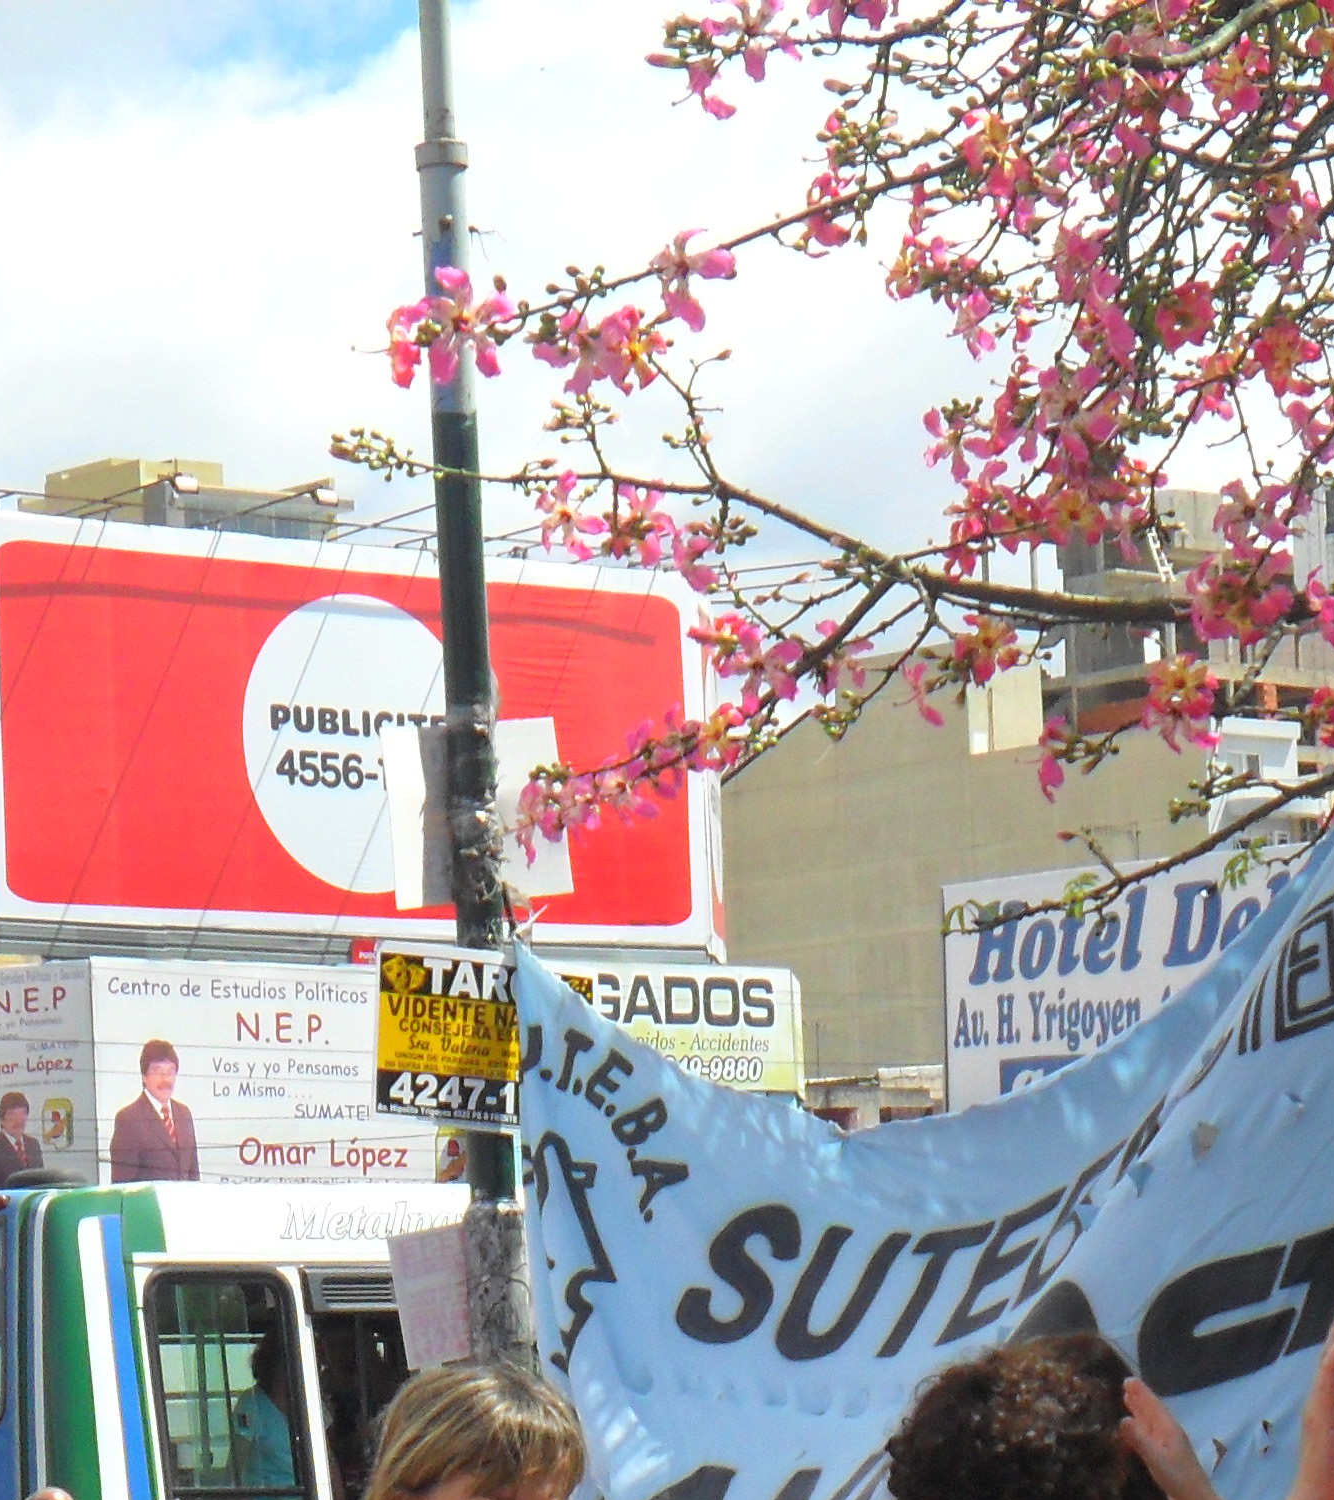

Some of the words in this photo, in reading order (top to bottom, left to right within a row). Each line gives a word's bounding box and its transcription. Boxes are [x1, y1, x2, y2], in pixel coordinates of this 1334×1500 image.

[968, 885, 1148, 986] Hotel
[107, 976, 170, 998] Centro
[179, 978, 202, 998] de
[210, 979, 286, 1001] Estudios
[295, 981, 368, 1004] Políticos
[388, 994, 487, 1025] VIDENTE
[953, 997, 989, 1049] Av.
[995, 992, 1021, 1045] H.
[1028, 987, 1143, 1052] Yrigoyen
[235, 1012, 331, 1046] N.E.P.
[399, 1018, 492, 1040] CONSEJERA
[689, 1032, 770, 1053] Accidentes
[27, 1055, 74, 1075] López
[212, 1057, 240, 1074] Vos
[246, 1062, 256, 1077] y
[262, 1062, 281, 1079] yo
[287, 1058, 360, 1077] Pensamos
[213, 1081, 230, 1098] Lo
[389, 1071, 515, 1114] 4247-1
[294, 1103, 371, 1122] SUMATE!
[238, 1136, 317, 1166] Omar
[329, 1136, 409, 1177] López
